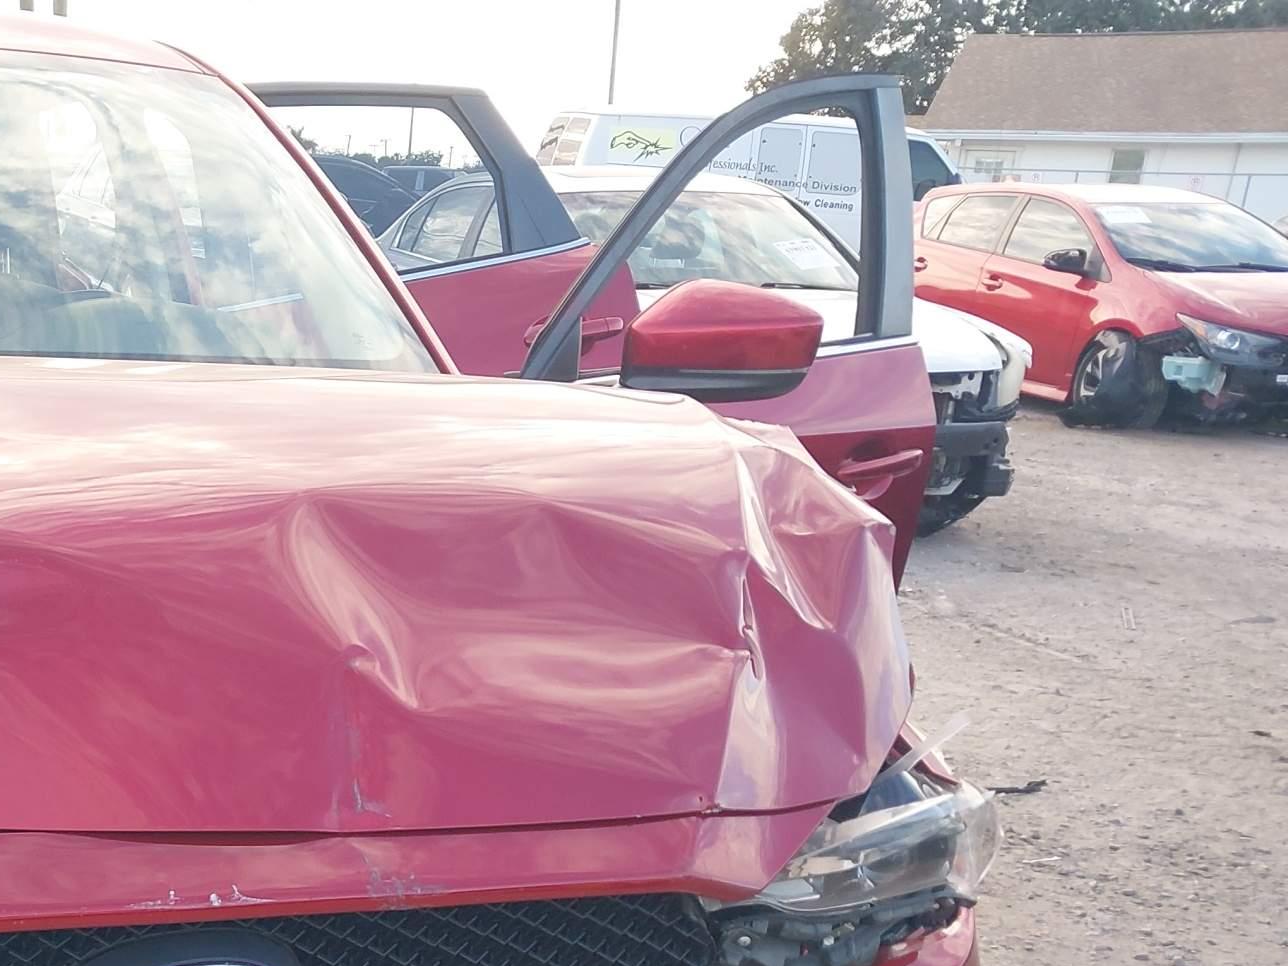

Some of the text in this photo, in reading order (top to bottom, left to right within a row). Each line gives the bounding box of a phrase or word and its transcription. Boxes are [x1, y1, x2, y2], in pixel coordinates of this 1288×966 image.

[759, 162, 779, 173] Inc.
[811, 181, 857, 193] Division
[814, 199, 854, 212] Cleaning
